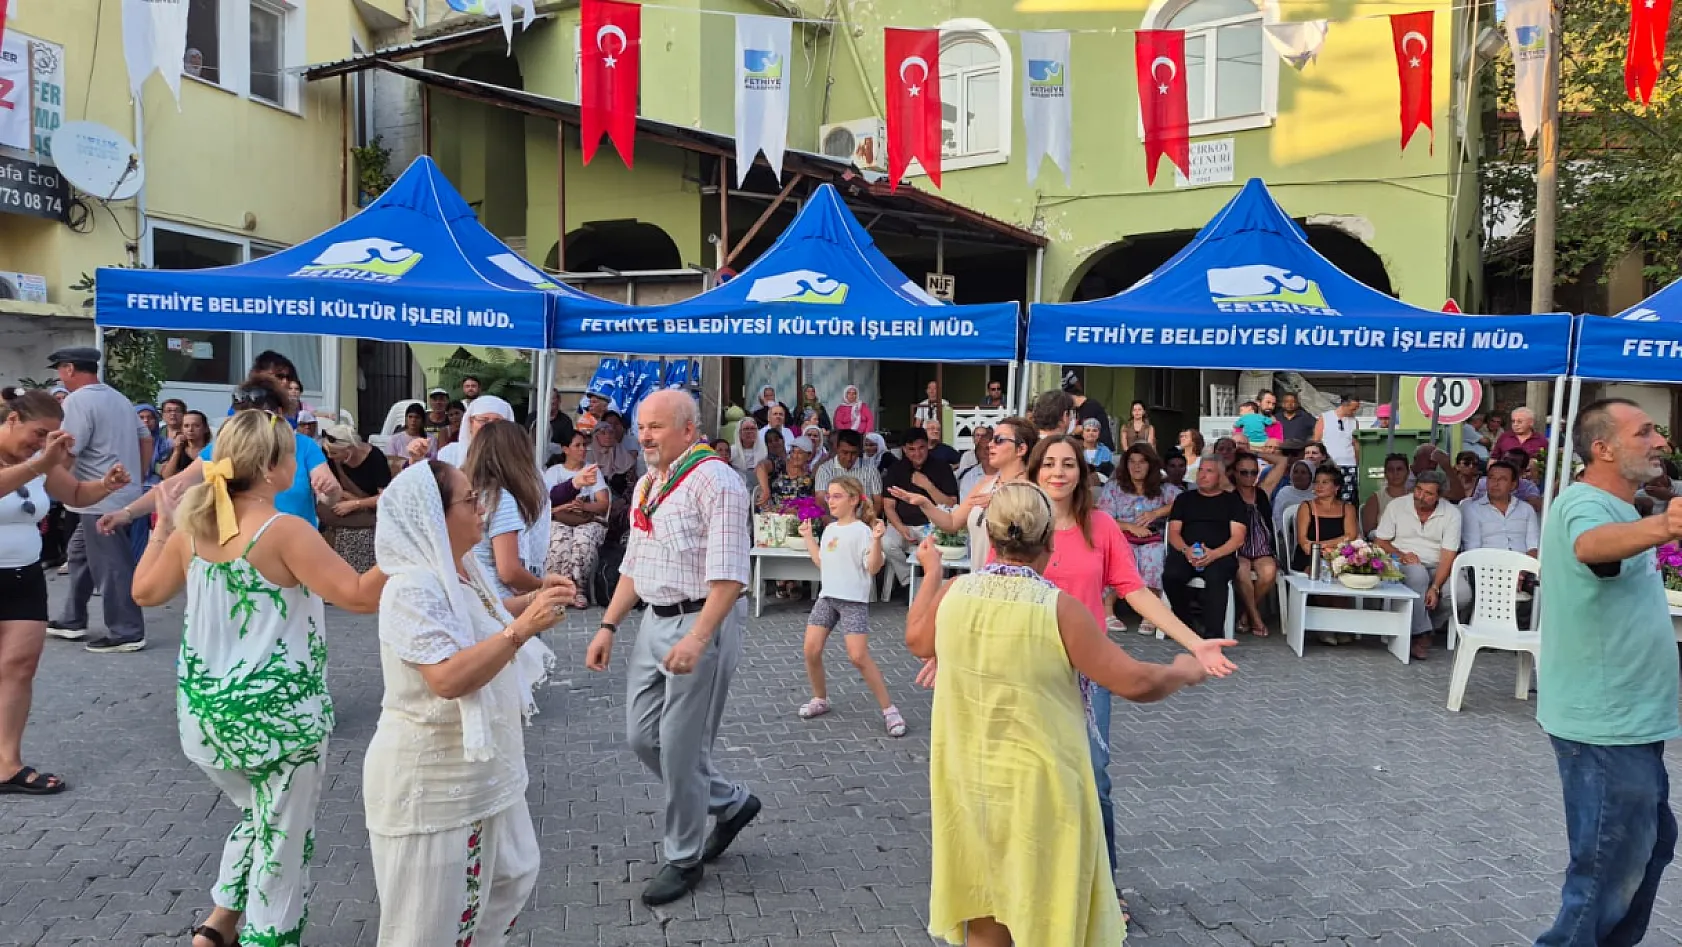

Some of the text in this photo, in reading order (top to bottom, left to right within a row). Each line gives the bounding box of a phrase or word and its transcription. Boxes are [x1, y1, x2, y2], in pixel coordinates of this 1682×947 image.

[28, 168, 60, 189] Erol
[24, 191, 41, 210] 08
[45, 195, 63, 214] 74
[126, 291, 515, 329] FETHİYE BELEDİYESİ KÜLTÜR İŞLERİ MÜD.
[580, 315, 979, 340] FETHİYE BELEDİYESİ KÜLTÜR İŞLERİ MÜD.
[1065, 323, 1529, 352] FETHİYE BELEDİYESİ KÜLTÜR İŞLERİ MÜD.
